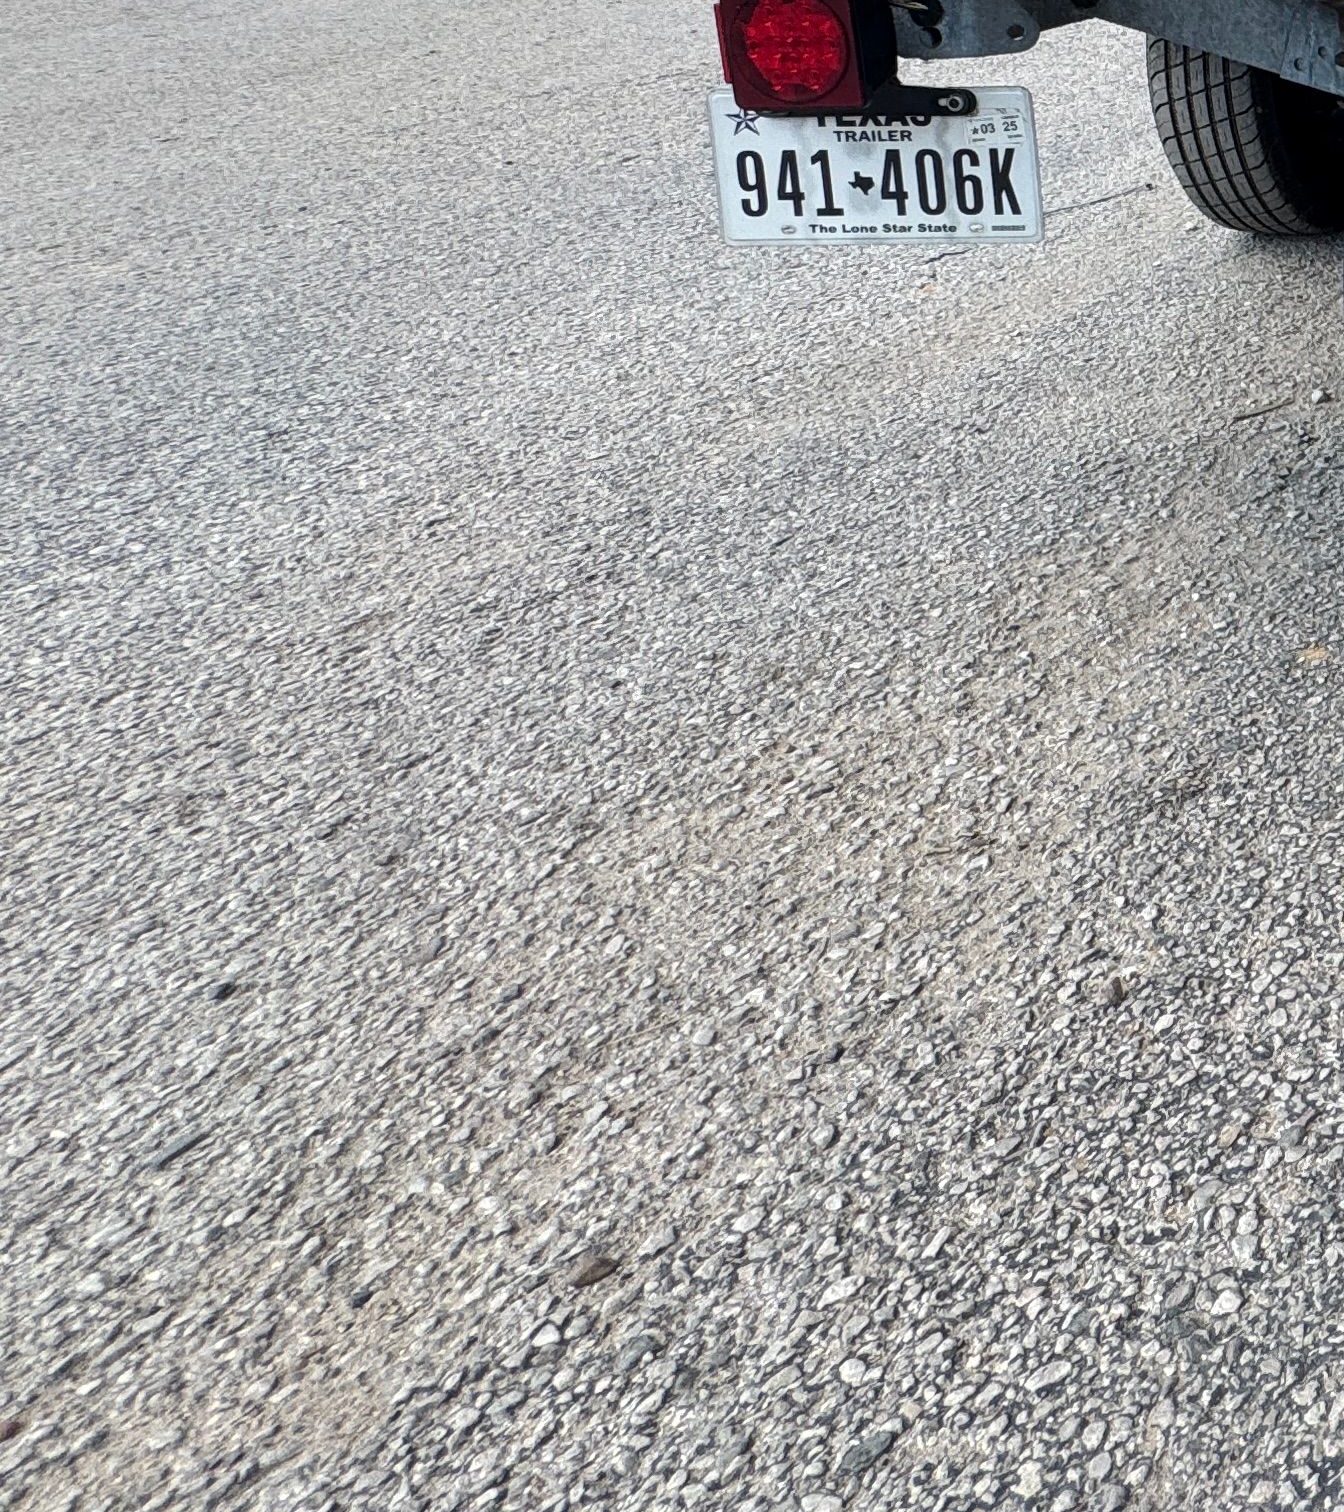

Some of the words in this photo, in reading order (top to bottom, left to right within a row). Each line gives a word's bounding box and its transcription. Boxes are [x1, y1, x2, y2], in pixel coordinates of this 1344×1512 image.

[980, 122, 996, 134] 03
[1002, 120, 1018, 132] 25
[833, 130, 913, 142] TRAILER
[736, 148, 845, 217] 941
[881, 147, 1022, 216] 406K
[808, 224, 837, 234] The
[842, 223, 878, 234] Lone
[882, 223, 913, 233] Star
[918, 223, 958, 233] State
